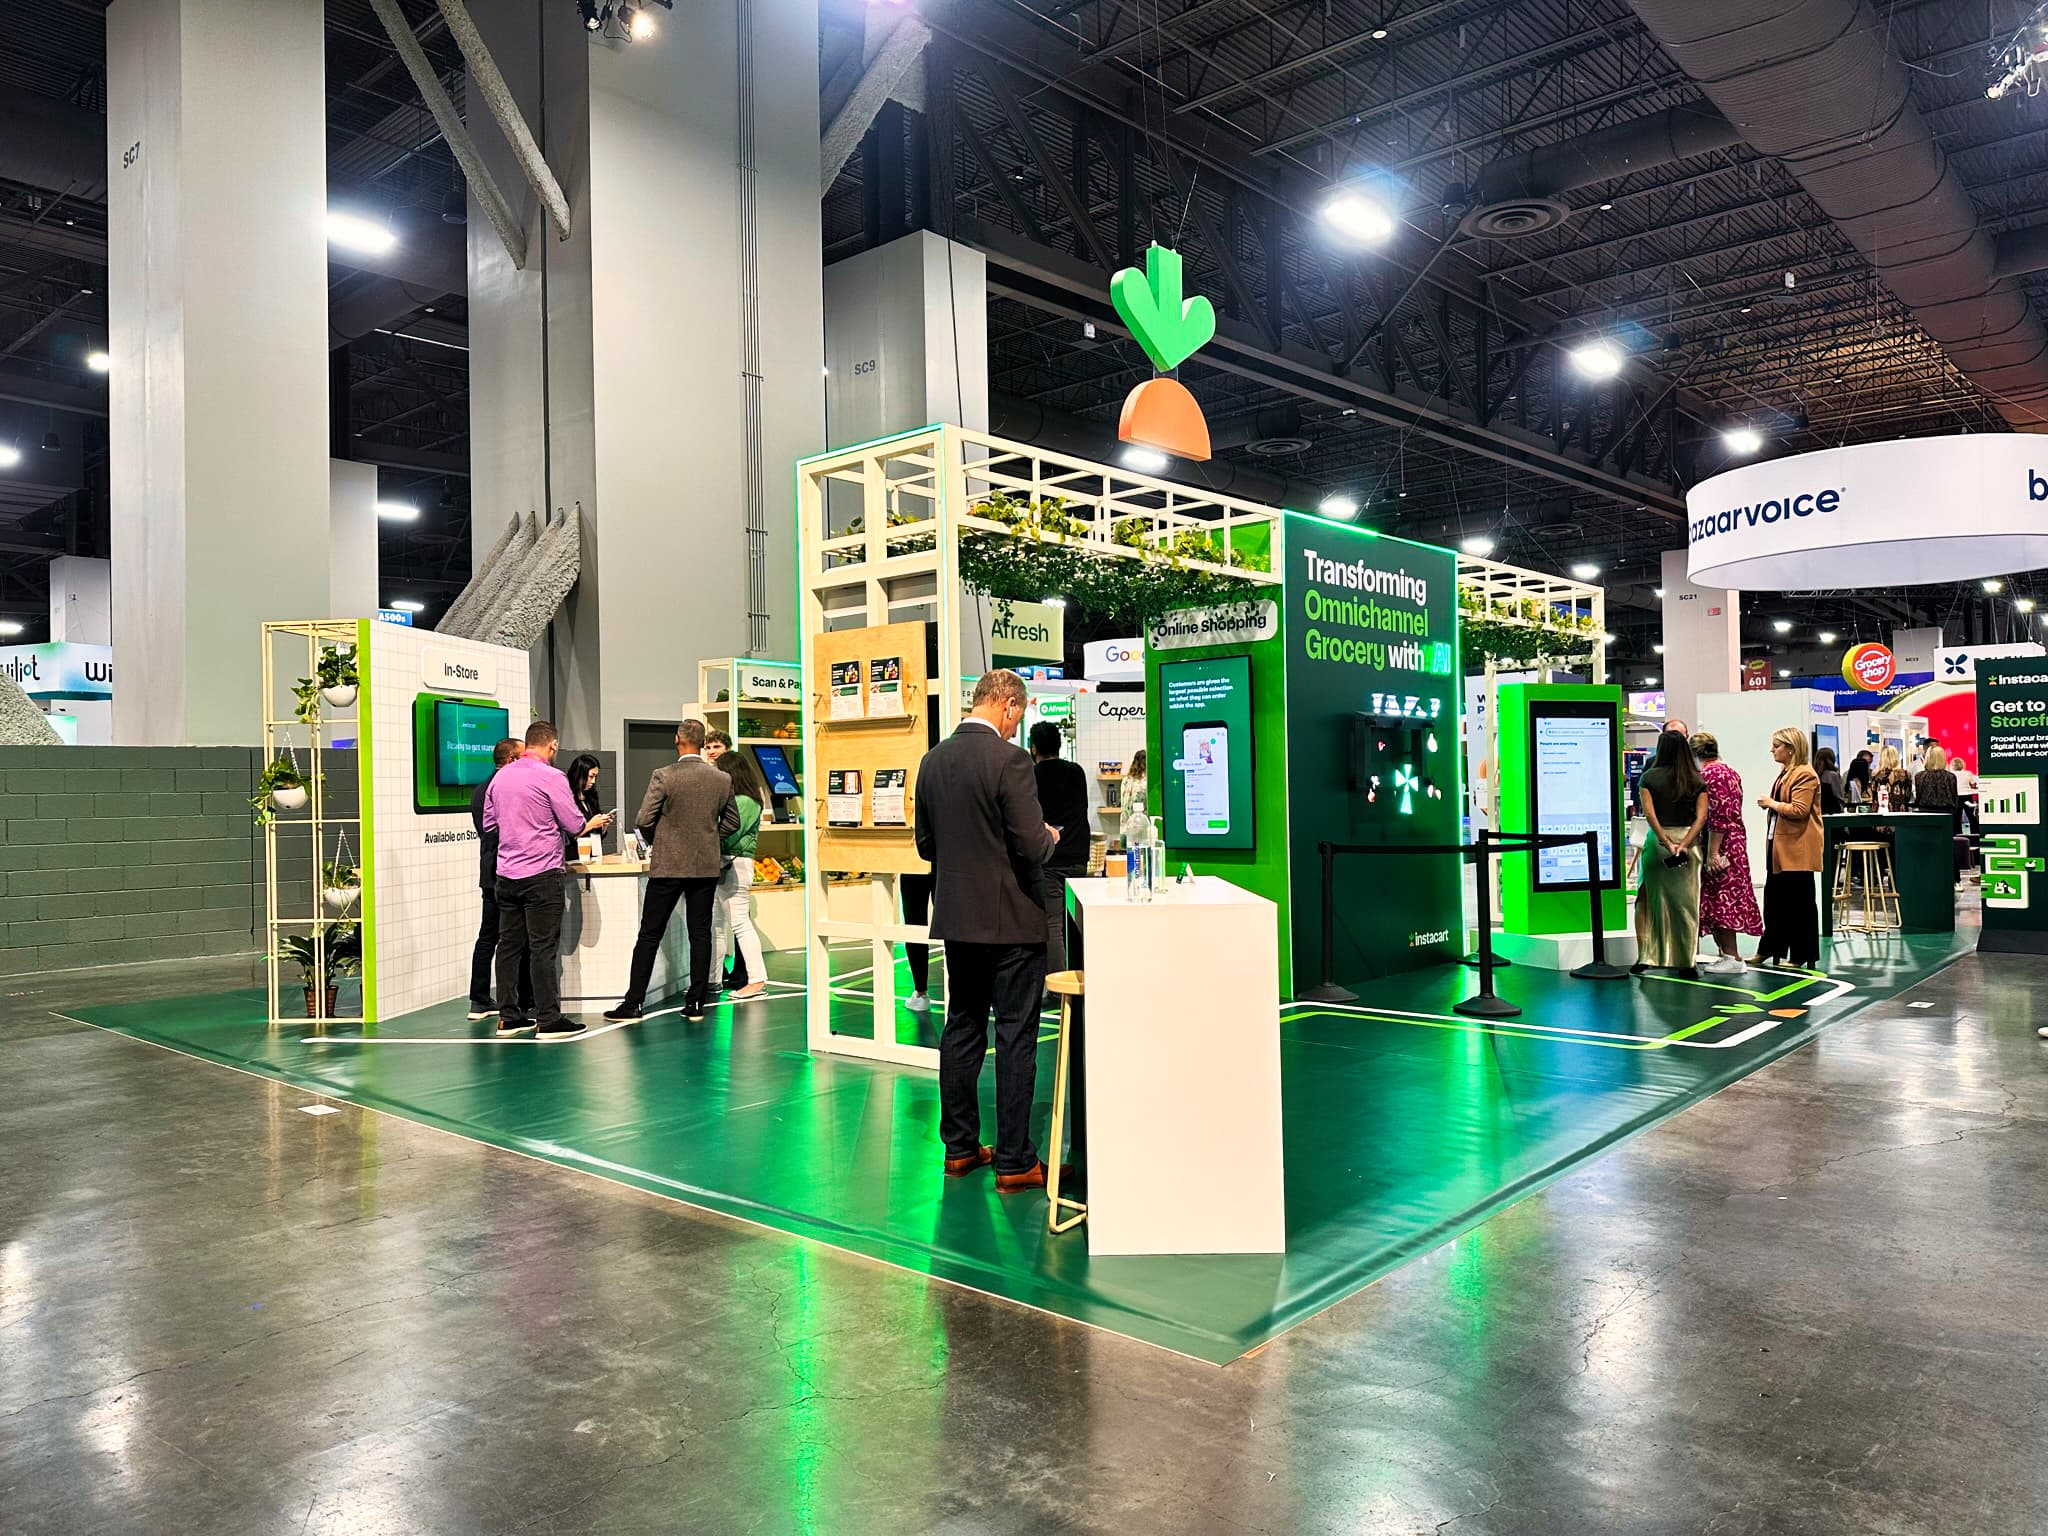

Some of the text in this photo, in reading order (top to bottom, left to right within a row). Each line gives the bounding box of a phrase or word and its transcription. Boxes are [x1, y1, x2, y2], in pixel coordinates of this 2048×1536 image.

[123, 140, 141, 169] SC7
[854, 359, 876, 376] SC9
[2028, 468, 2048, 502] b
[1689, 488, 1840, 544] azaarvoice
[1303, 548, 1427, 607] Transforming
[1679, 593, 1697, 601] SC21
[1304, 588, 1429, 637] Omnichannel
[1157, 614, 1267, 637] Online Shopping
[1305, 628, 1452, 674] Grocery with AI
[444, 662, 479, 680] In-Store
[1854, 655, 1891, 671] Grocery
[1862, 666, 1886, 679] shop
[1998, 674, 2048, 685] instaca
[752, 676, 801, 690] Scan & Pa
[1748, 677, 1767, 686] 601
[1098, 700, 1146, 721] Caper
[1990, 699, 2046, 714] Get to
[1990, 735, 2016, 743] Propel
[2017, 735, 2036, 743] your
[1990, 742, 2015, 751] digital
[2015, 742, 2039, 750] future
[1990, 750, 2025, 758] powerful
[424, 829, 479, 844] Available on Sto
[1414, 929, 1450, 947] instacart
